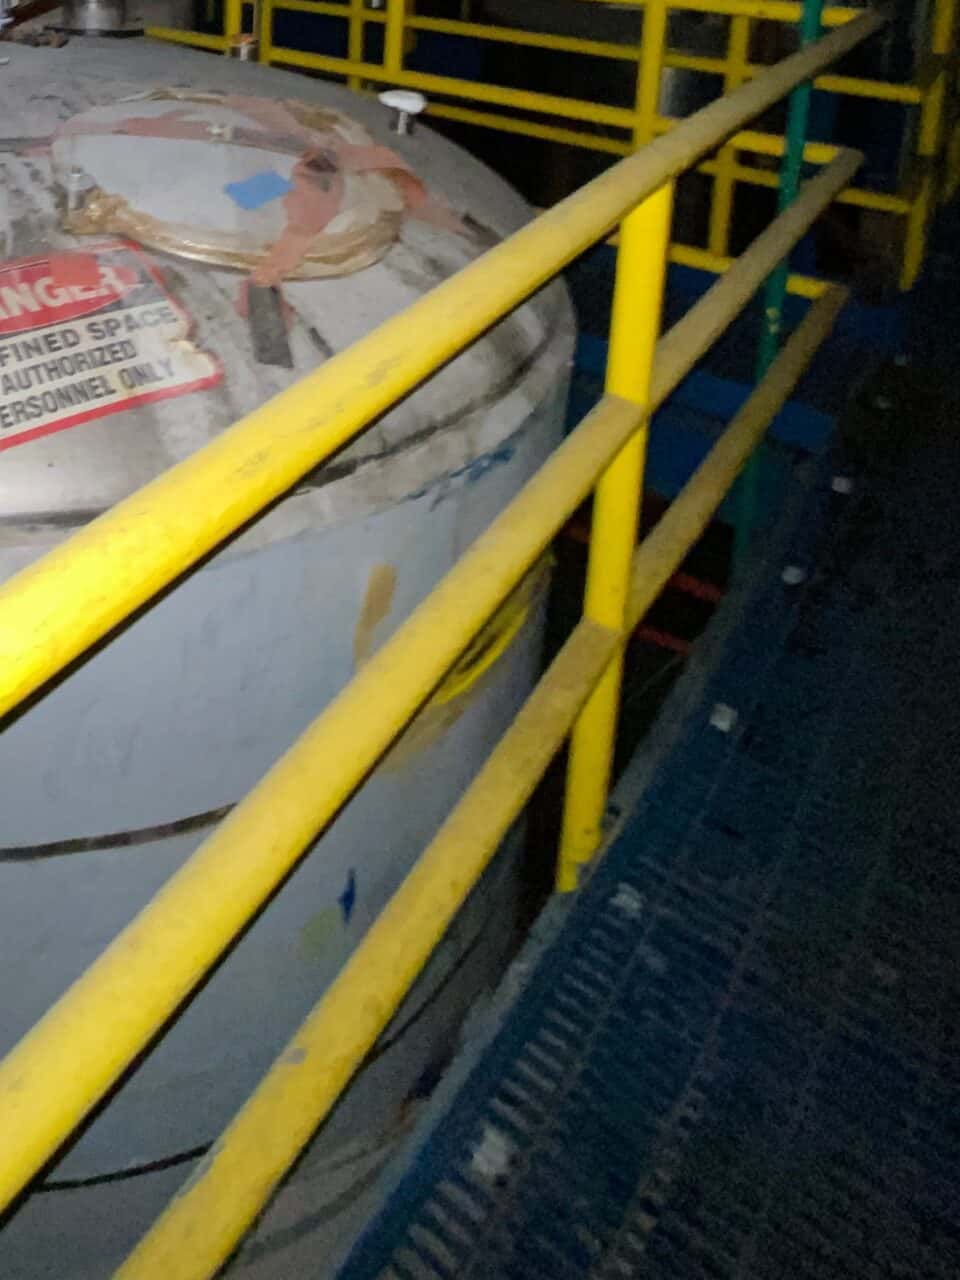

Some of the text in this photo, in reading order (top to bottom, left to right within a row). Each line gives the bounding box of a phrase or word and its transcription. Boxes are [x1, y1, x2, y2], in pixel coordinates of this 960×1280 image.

[89, 306, 178, 340] SPACE
[1, 339, 138, 396] AUTHORIZED
[120, 357, 175, 389] ONLY
